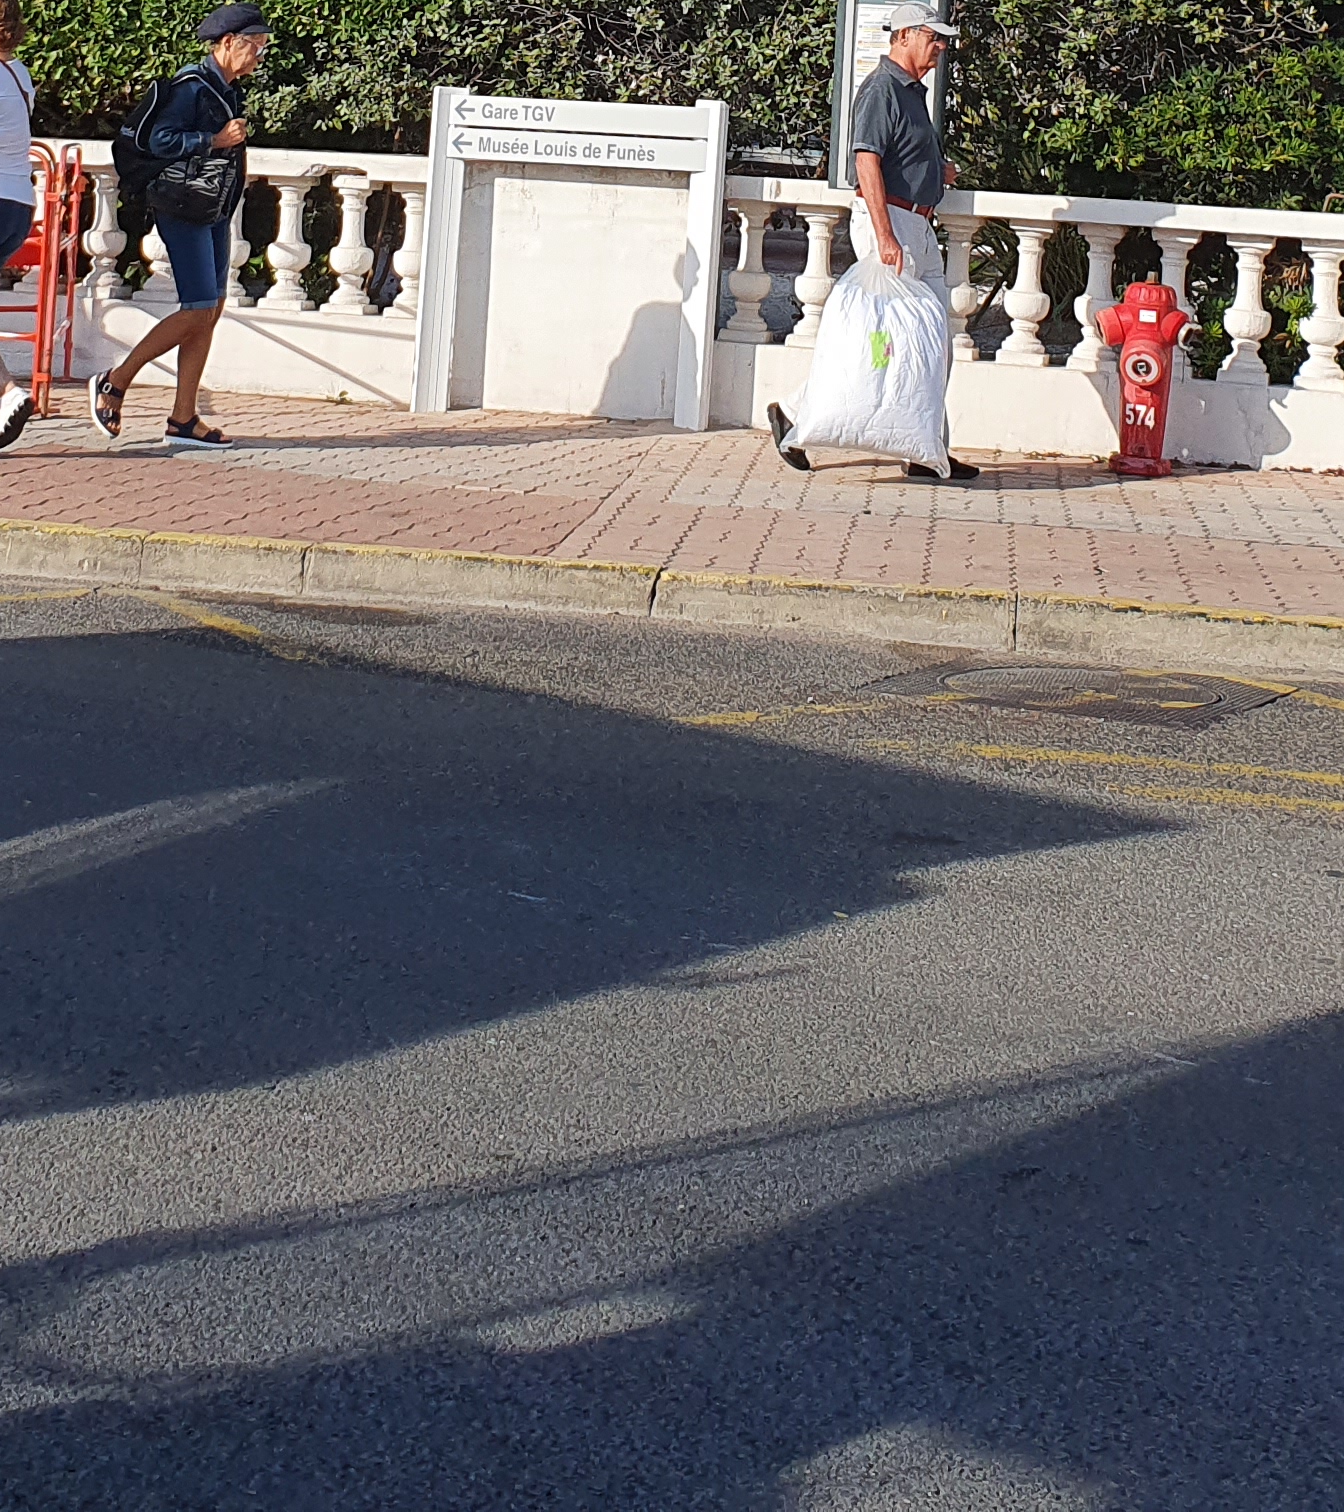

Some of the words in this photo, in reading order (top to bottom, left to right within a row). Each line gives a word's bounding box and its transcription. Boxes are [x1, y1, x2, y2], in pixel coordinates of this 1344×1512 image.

[481, 103, 518, 121] Gare
[522, 105, 556, 122] TGV
[478, 136, 529, 156] Musée
[533, 140, 577, 158] Louis
[582, 142, 601, 159] de
[606, 143, 656, 162] Funès
[1125, 403, 1156, 430] 574
